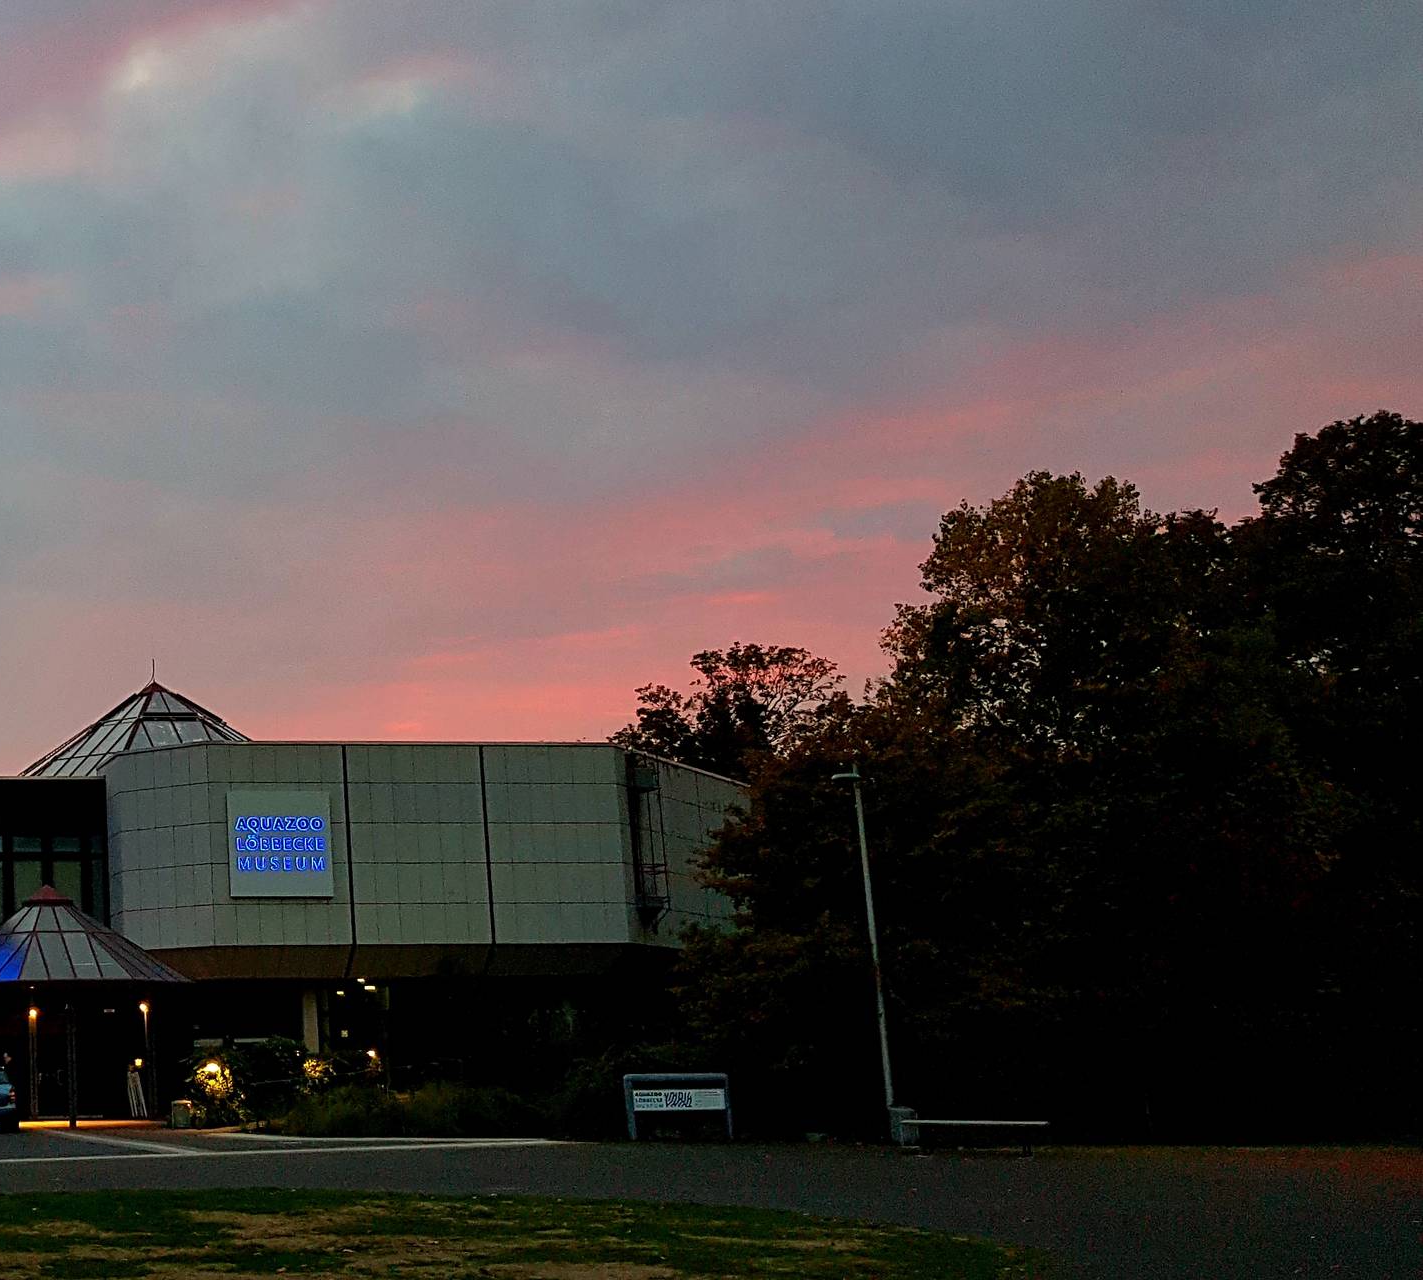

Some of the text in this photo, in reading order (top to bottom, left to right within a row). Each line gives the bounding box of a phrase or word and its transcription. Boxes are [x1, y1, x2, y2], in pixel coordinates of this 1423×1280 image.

[235, 816, 324, 833] AQUAZOO
[236, 834, 326, 851] LÖBBECKE
[237, 856, 326, 871] MUSEUM
